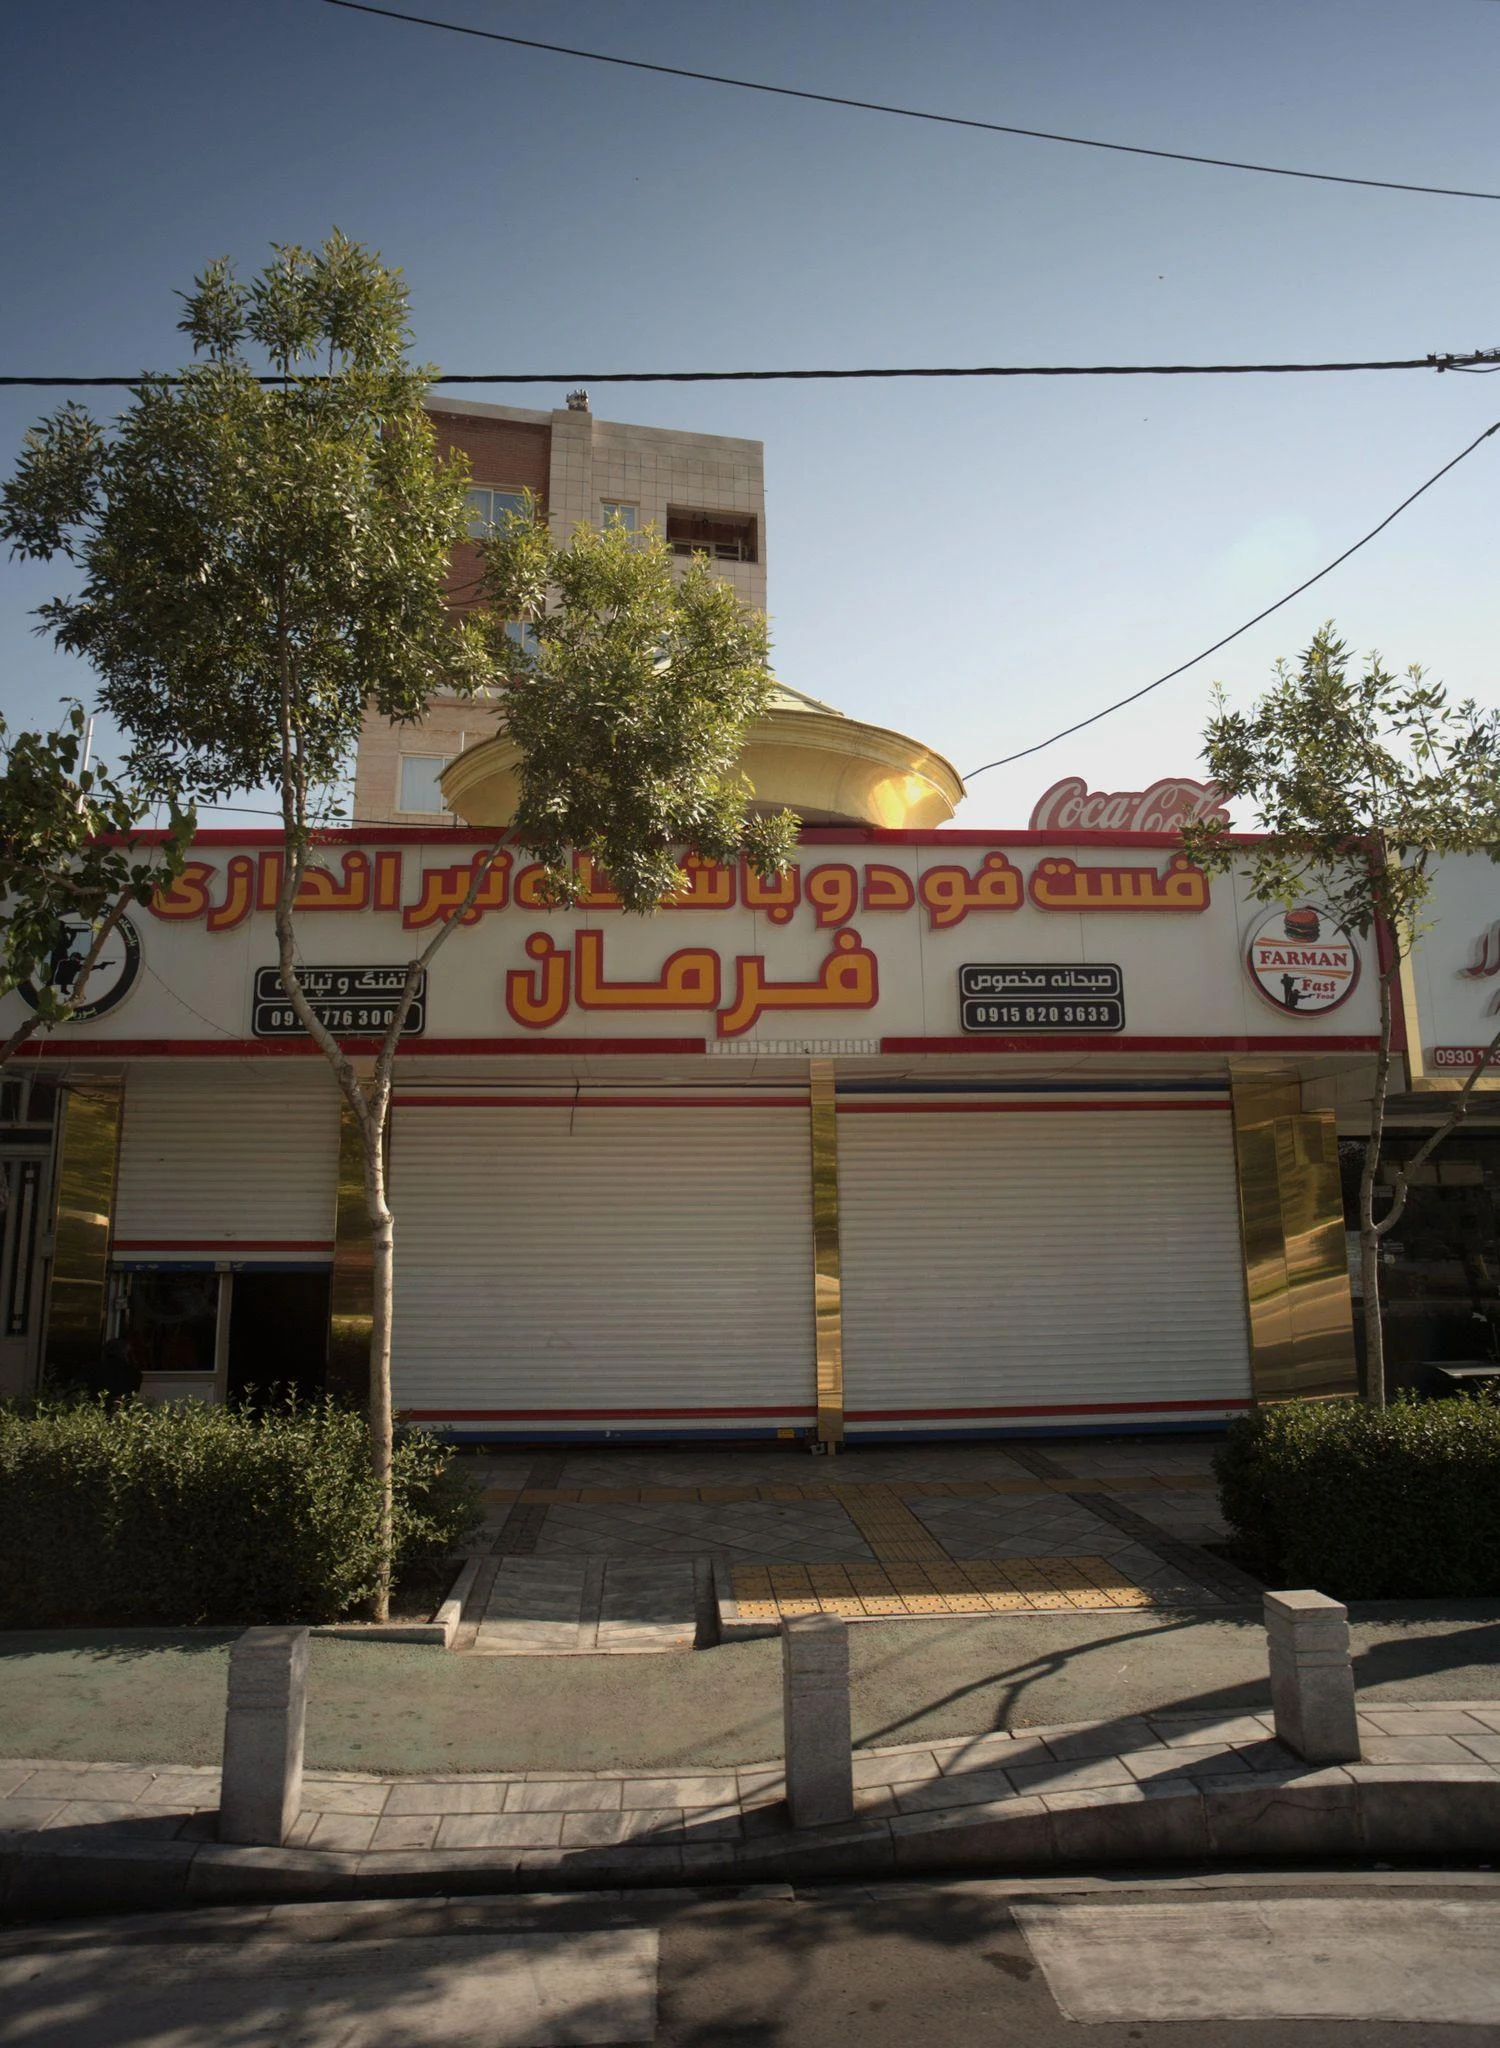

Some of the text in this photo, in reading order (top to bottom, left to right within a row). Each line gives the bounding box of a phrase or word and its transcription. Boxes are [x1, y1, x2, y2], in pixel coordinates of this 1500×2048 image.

[513, 848, 799, 924] باشاه
[1029, 850, 1211, 911] فست
[1259, 950, 1348, 967] FARMAN
[274, 971, 407, 996] تفنگ و تپانه
[506, 927, 880, 1039] فرمان
[970, 971, 1112, 992] صبحانه مخصوص
[1301, 979, 1337, 992] Fast
[271, 1010, 406, 1026] 09 776 300
[976, 1007, 1110, 1022] 0915 820 3633
[1436, 1049, 1474, 1064] 0930
